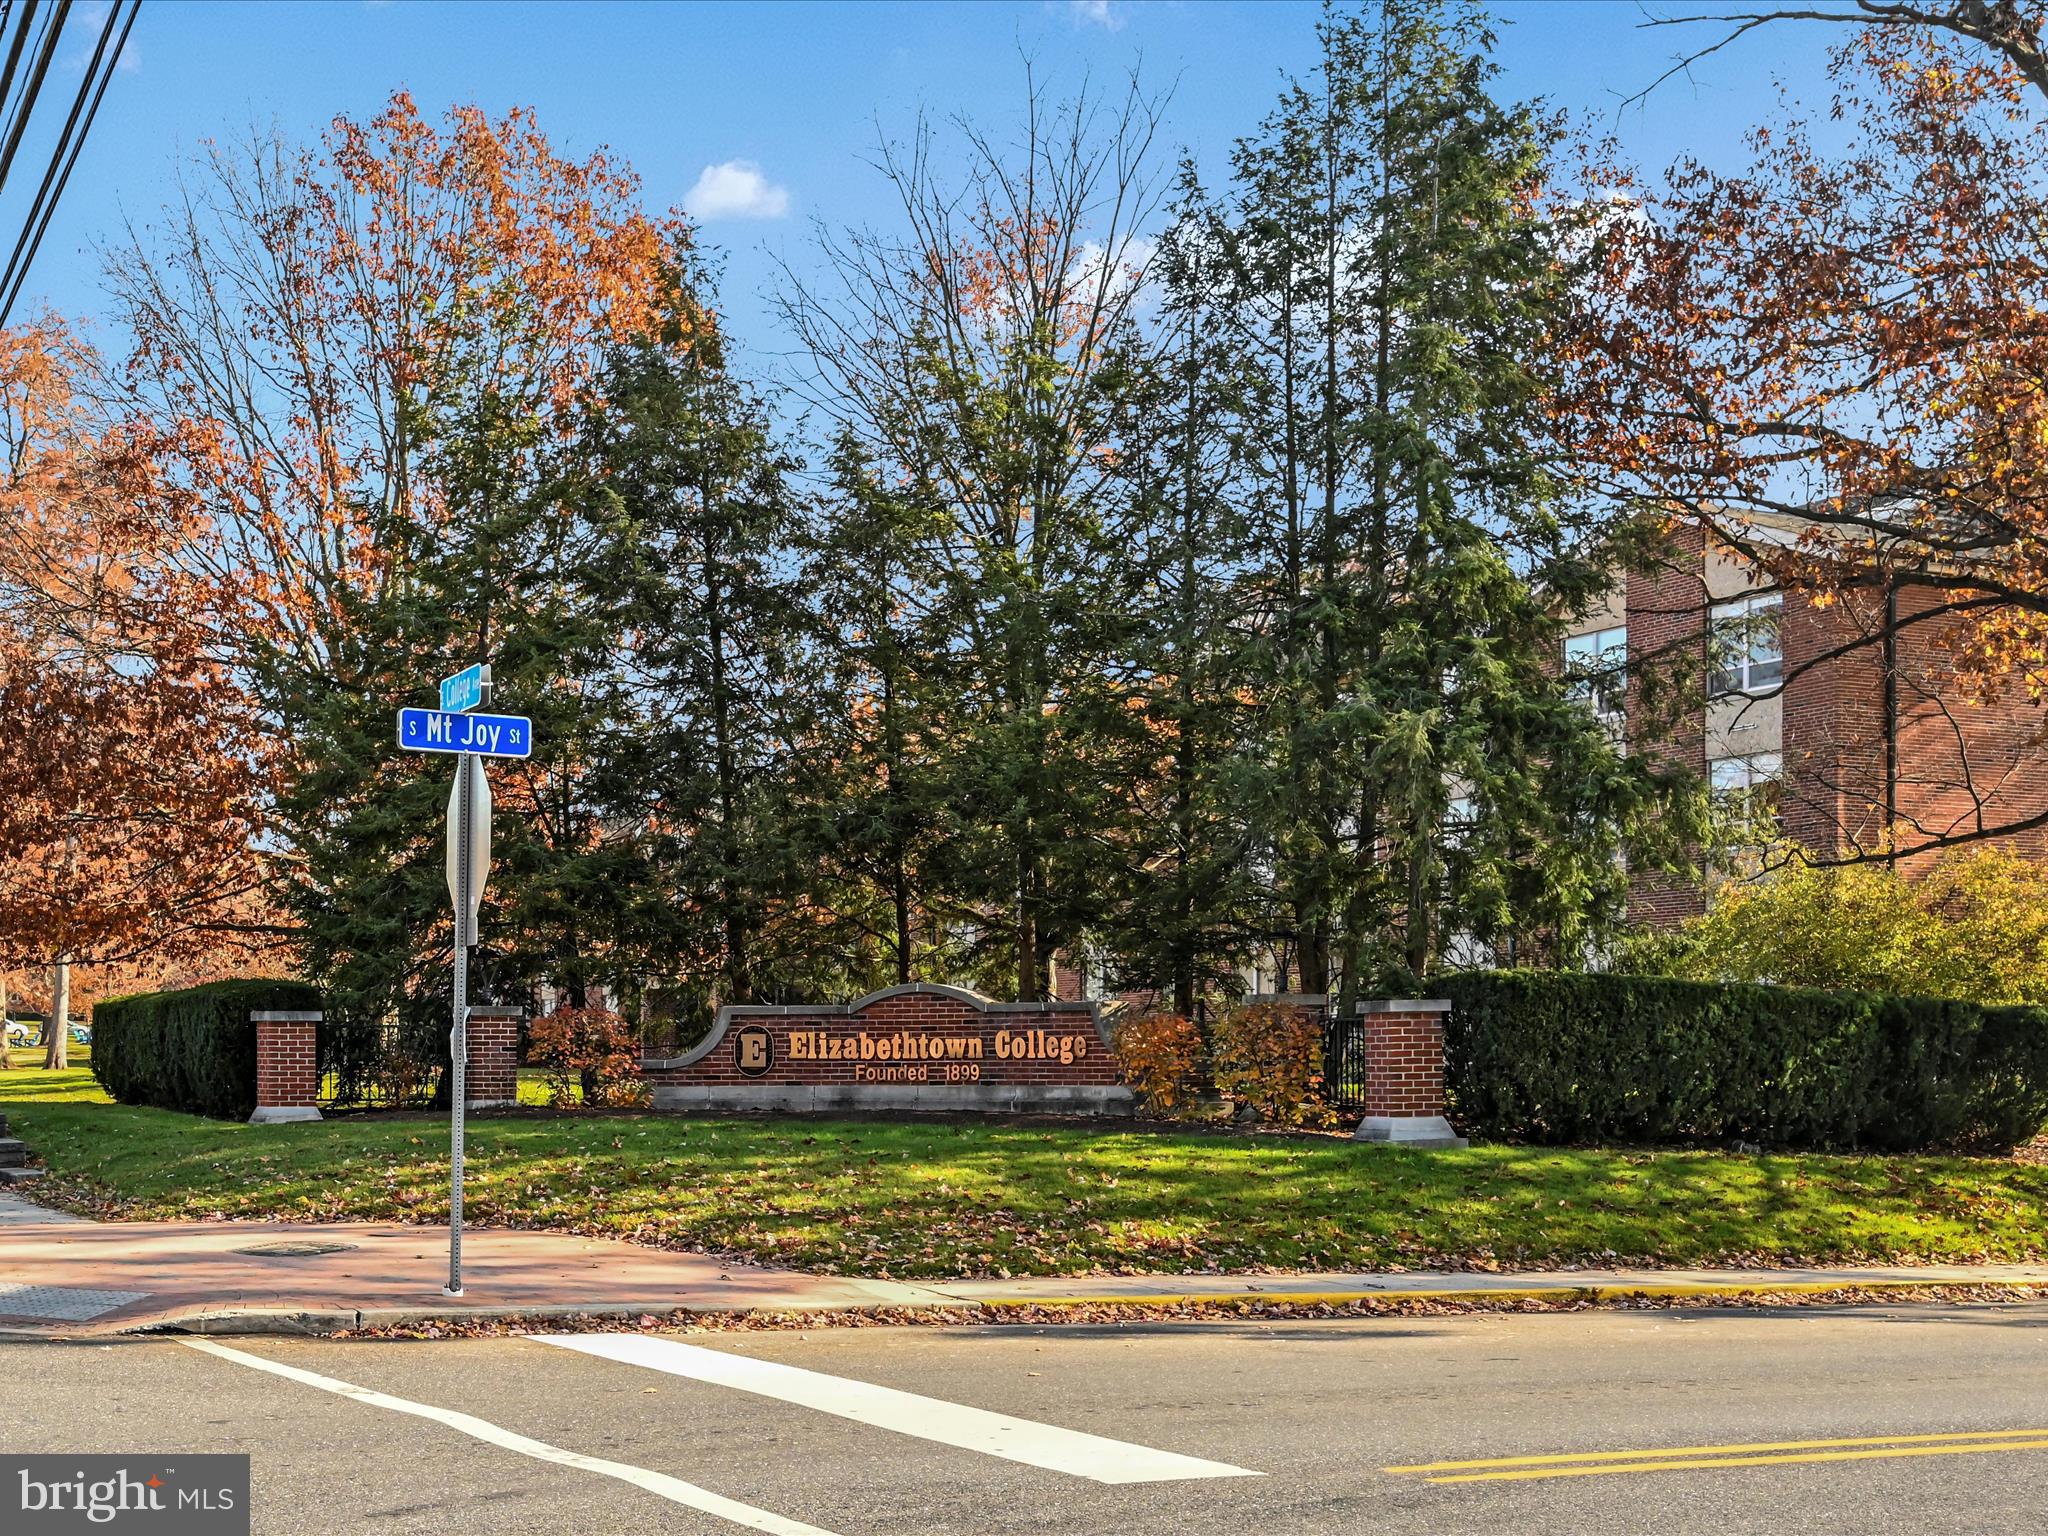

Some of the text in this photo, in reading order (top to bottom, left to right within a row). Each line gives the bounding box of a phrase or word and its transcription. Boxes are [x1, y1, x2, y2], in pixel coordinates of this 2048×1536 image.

[409, 713, 521, 752] S Mt Joy St
[740, 1034, 767, 1068] E
[788, 1031, 983, 1061] Elizabethtown
[995, 1030, 1087, 1065] College
[854, 1064, 980, 1081] Founded 1899
